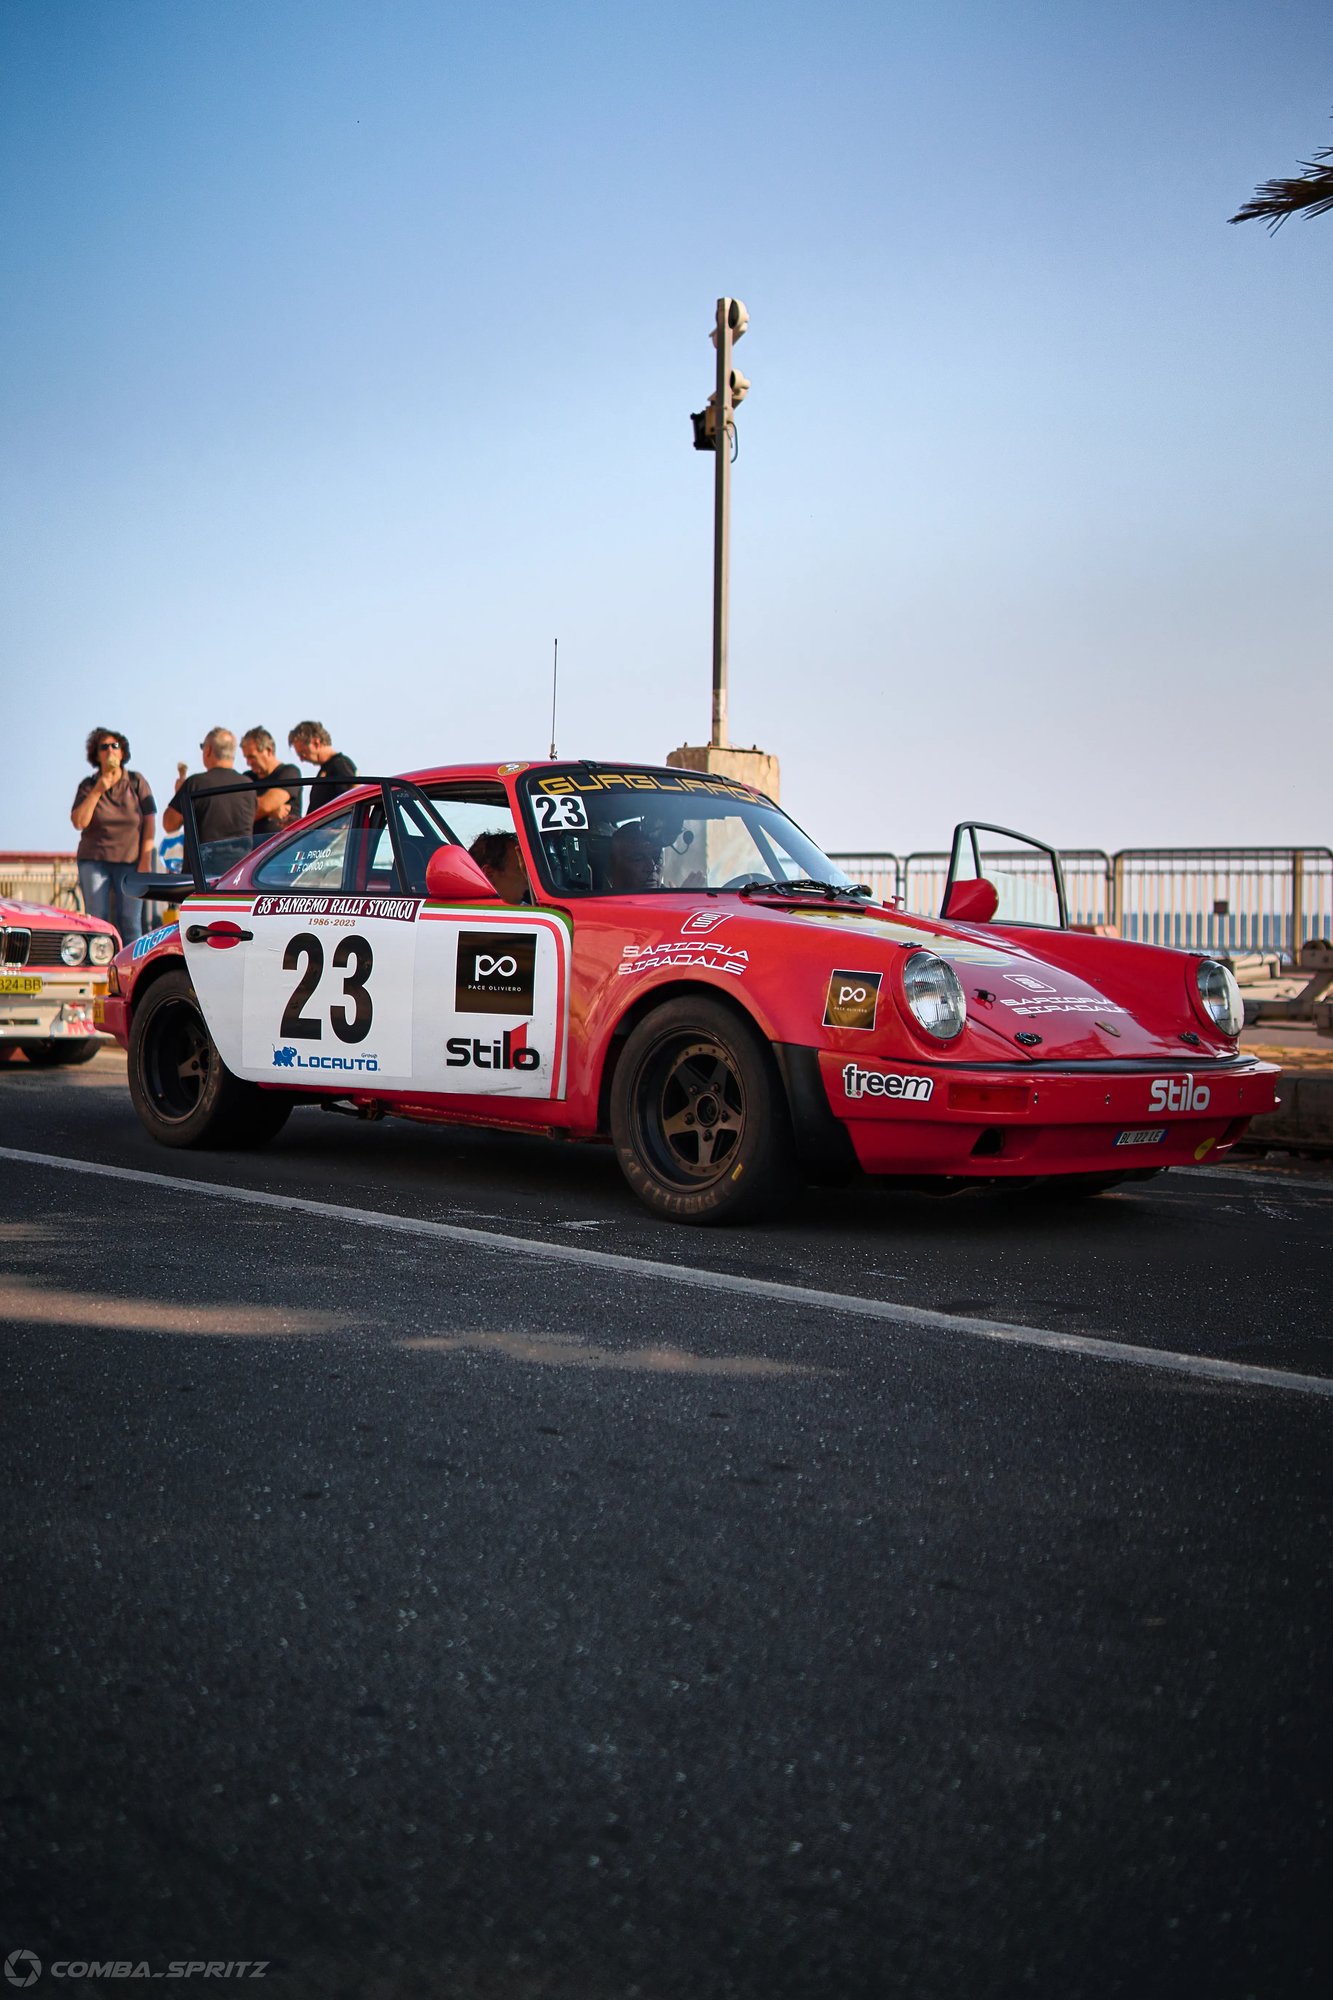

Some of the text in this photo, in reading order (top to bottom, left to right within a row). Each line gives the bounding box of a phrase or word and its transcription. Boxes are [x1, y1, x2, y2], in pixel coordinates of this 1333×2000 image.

[536, 796, 587, 829] 23
[275, 898, 328, 913] SANREMO
[329, 898, 367, 914] RALLY
[366, 900, 415, 920] STORICO
[617, 955, 747, 976] STRADALE
[622, 942, 750, 962] SARTORIA
[280, 932, 374, 1044] 23
[446, 1022, 540, 1071] Stilo
[297, 1056, 378, 1072] LOCAUTO
[843, 1065, 932, 1099] freem
[1148, 1073, 1210, 1112] Stilo
